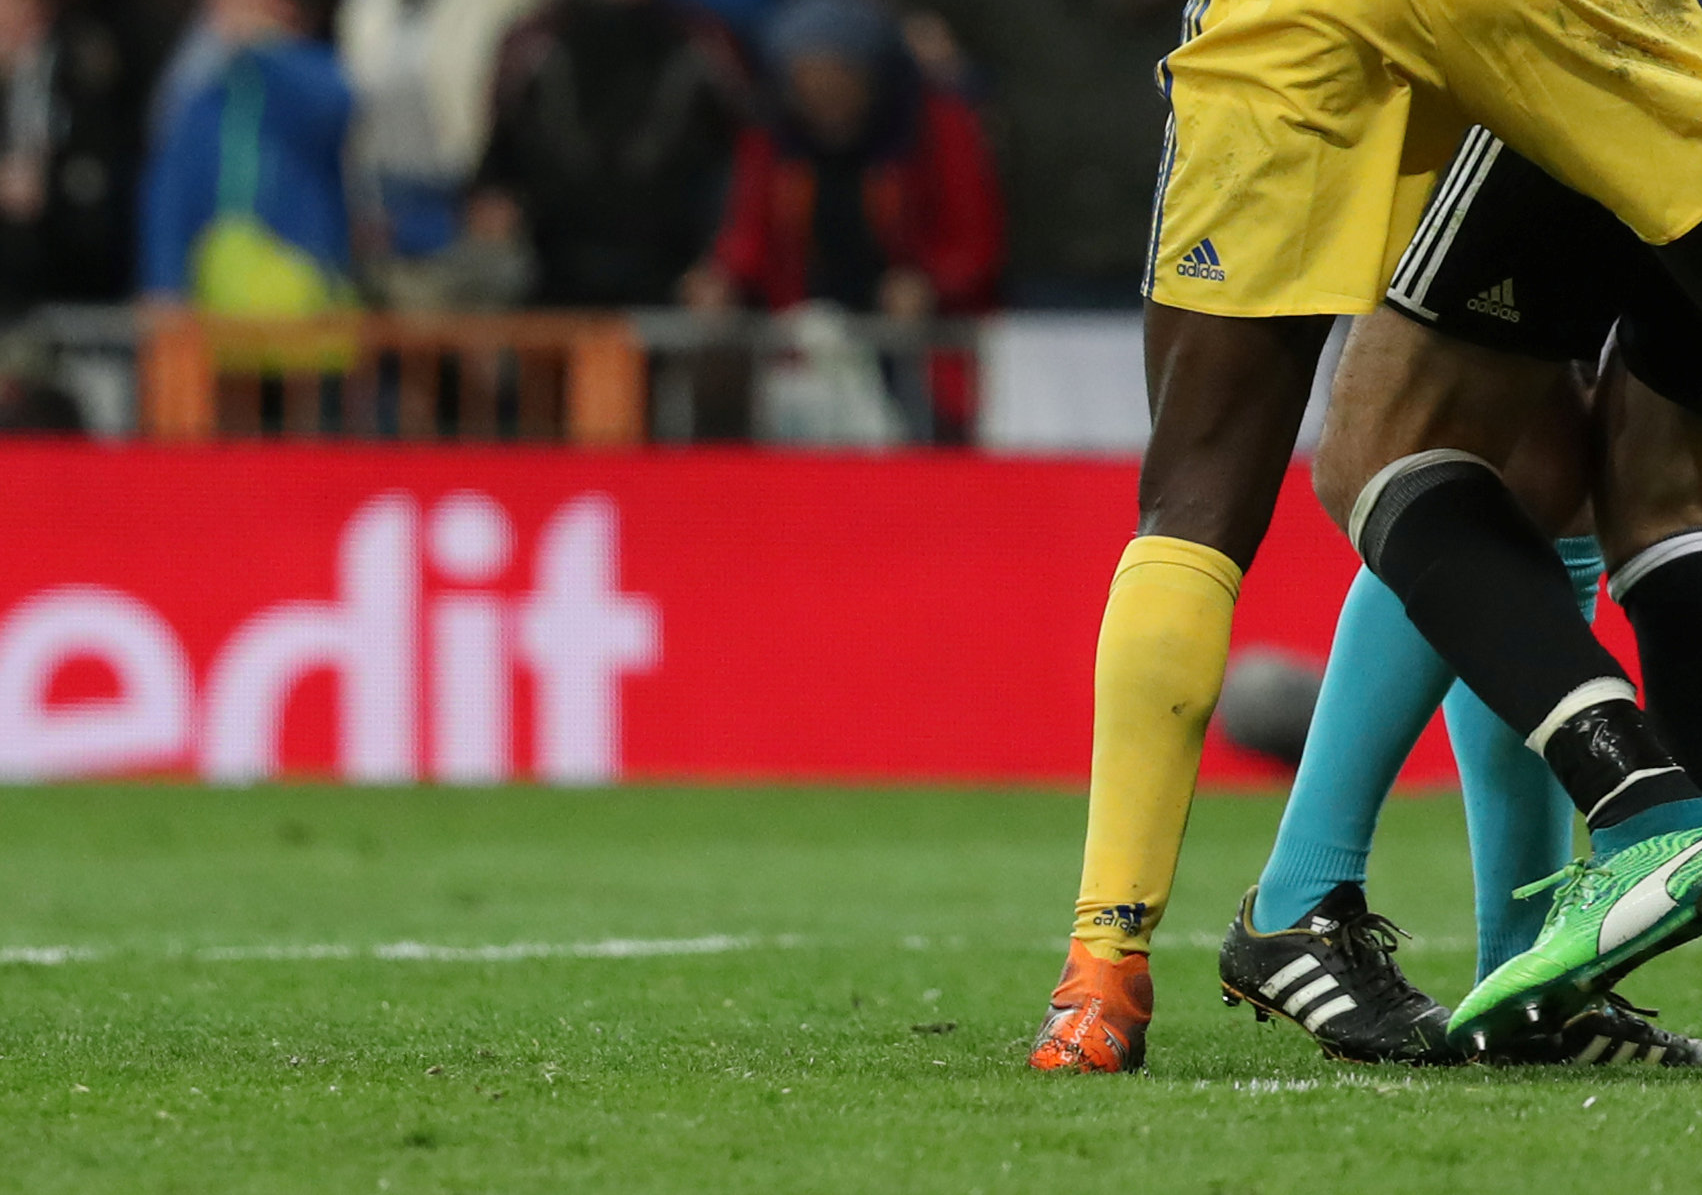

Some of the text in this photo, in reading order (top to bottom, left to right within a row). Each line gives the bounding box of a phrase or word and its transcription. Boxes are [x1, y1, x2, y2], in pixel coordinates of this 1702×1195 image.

[1176, 262, 1226, 282] adidas
[1467, 298, 1521, 323] adidas
[0, 488, 664, 787] edit
